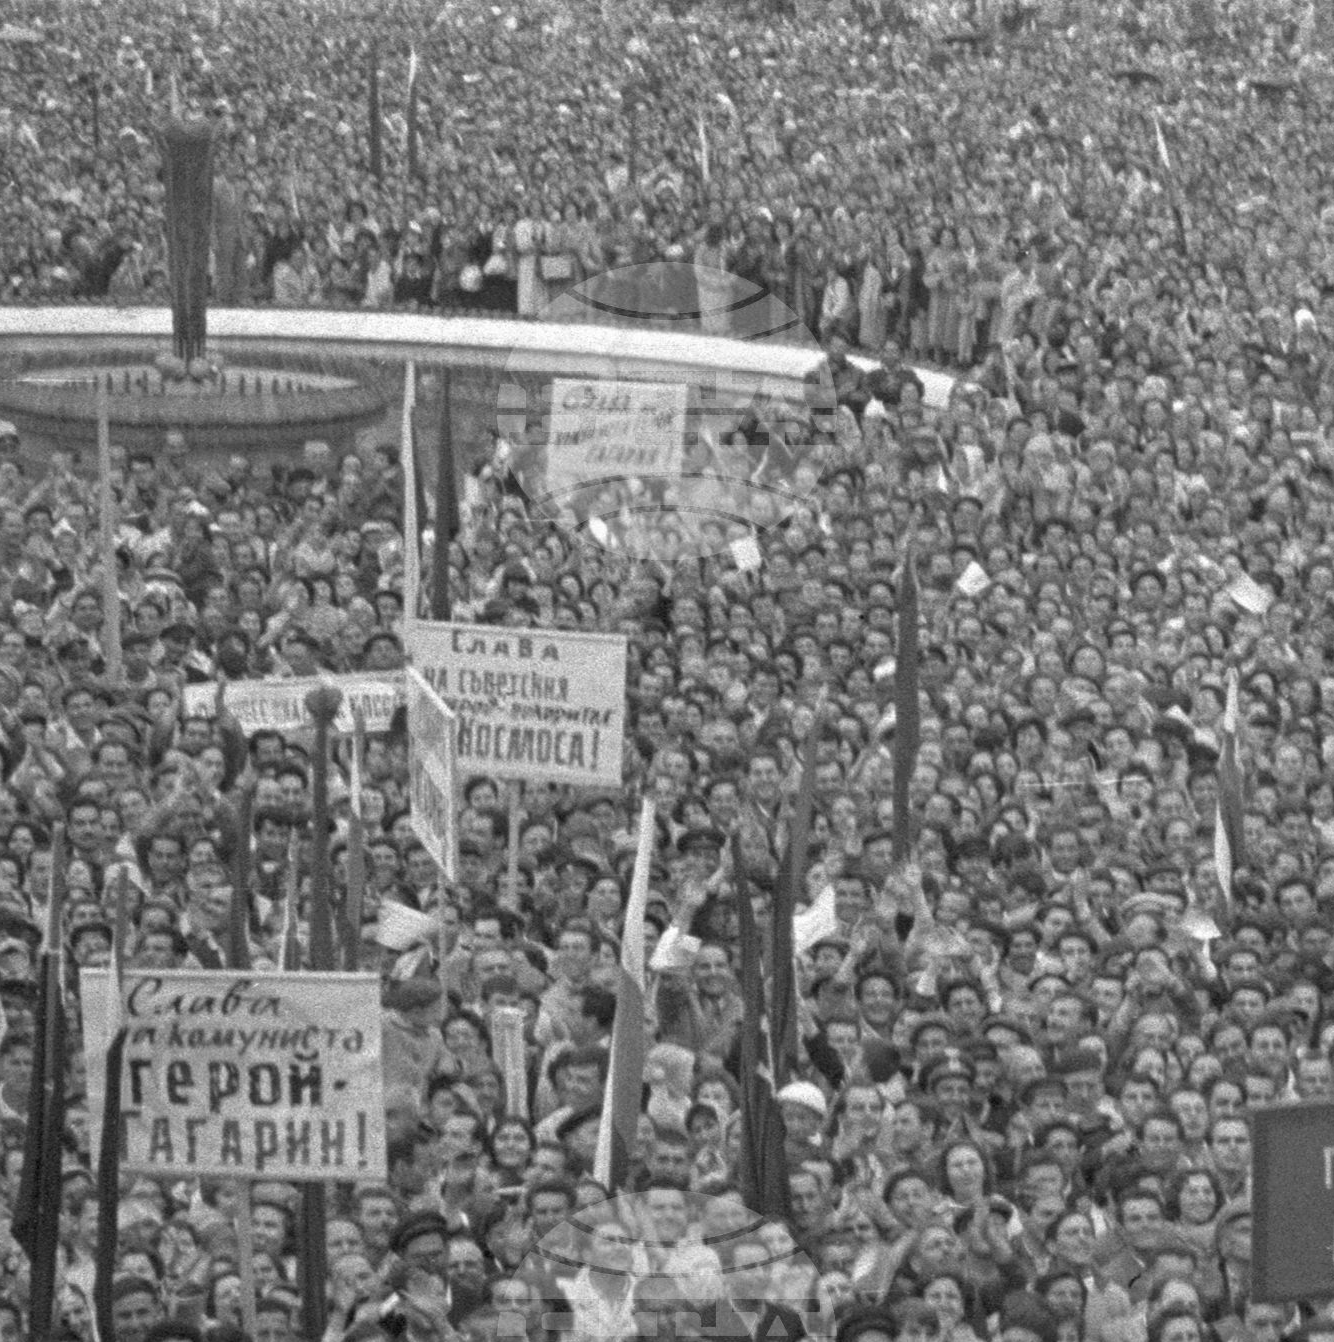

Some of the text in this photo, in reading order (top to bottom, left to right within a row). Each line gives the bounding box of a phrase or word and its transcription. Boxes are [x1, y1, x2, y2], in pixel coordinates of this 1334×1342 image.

[457, 717, 600, 772] КОСМОСА!
[127, 977, 282, 1017] Слава
[119, 1110, 369, 1172] ГАГАРИН!
